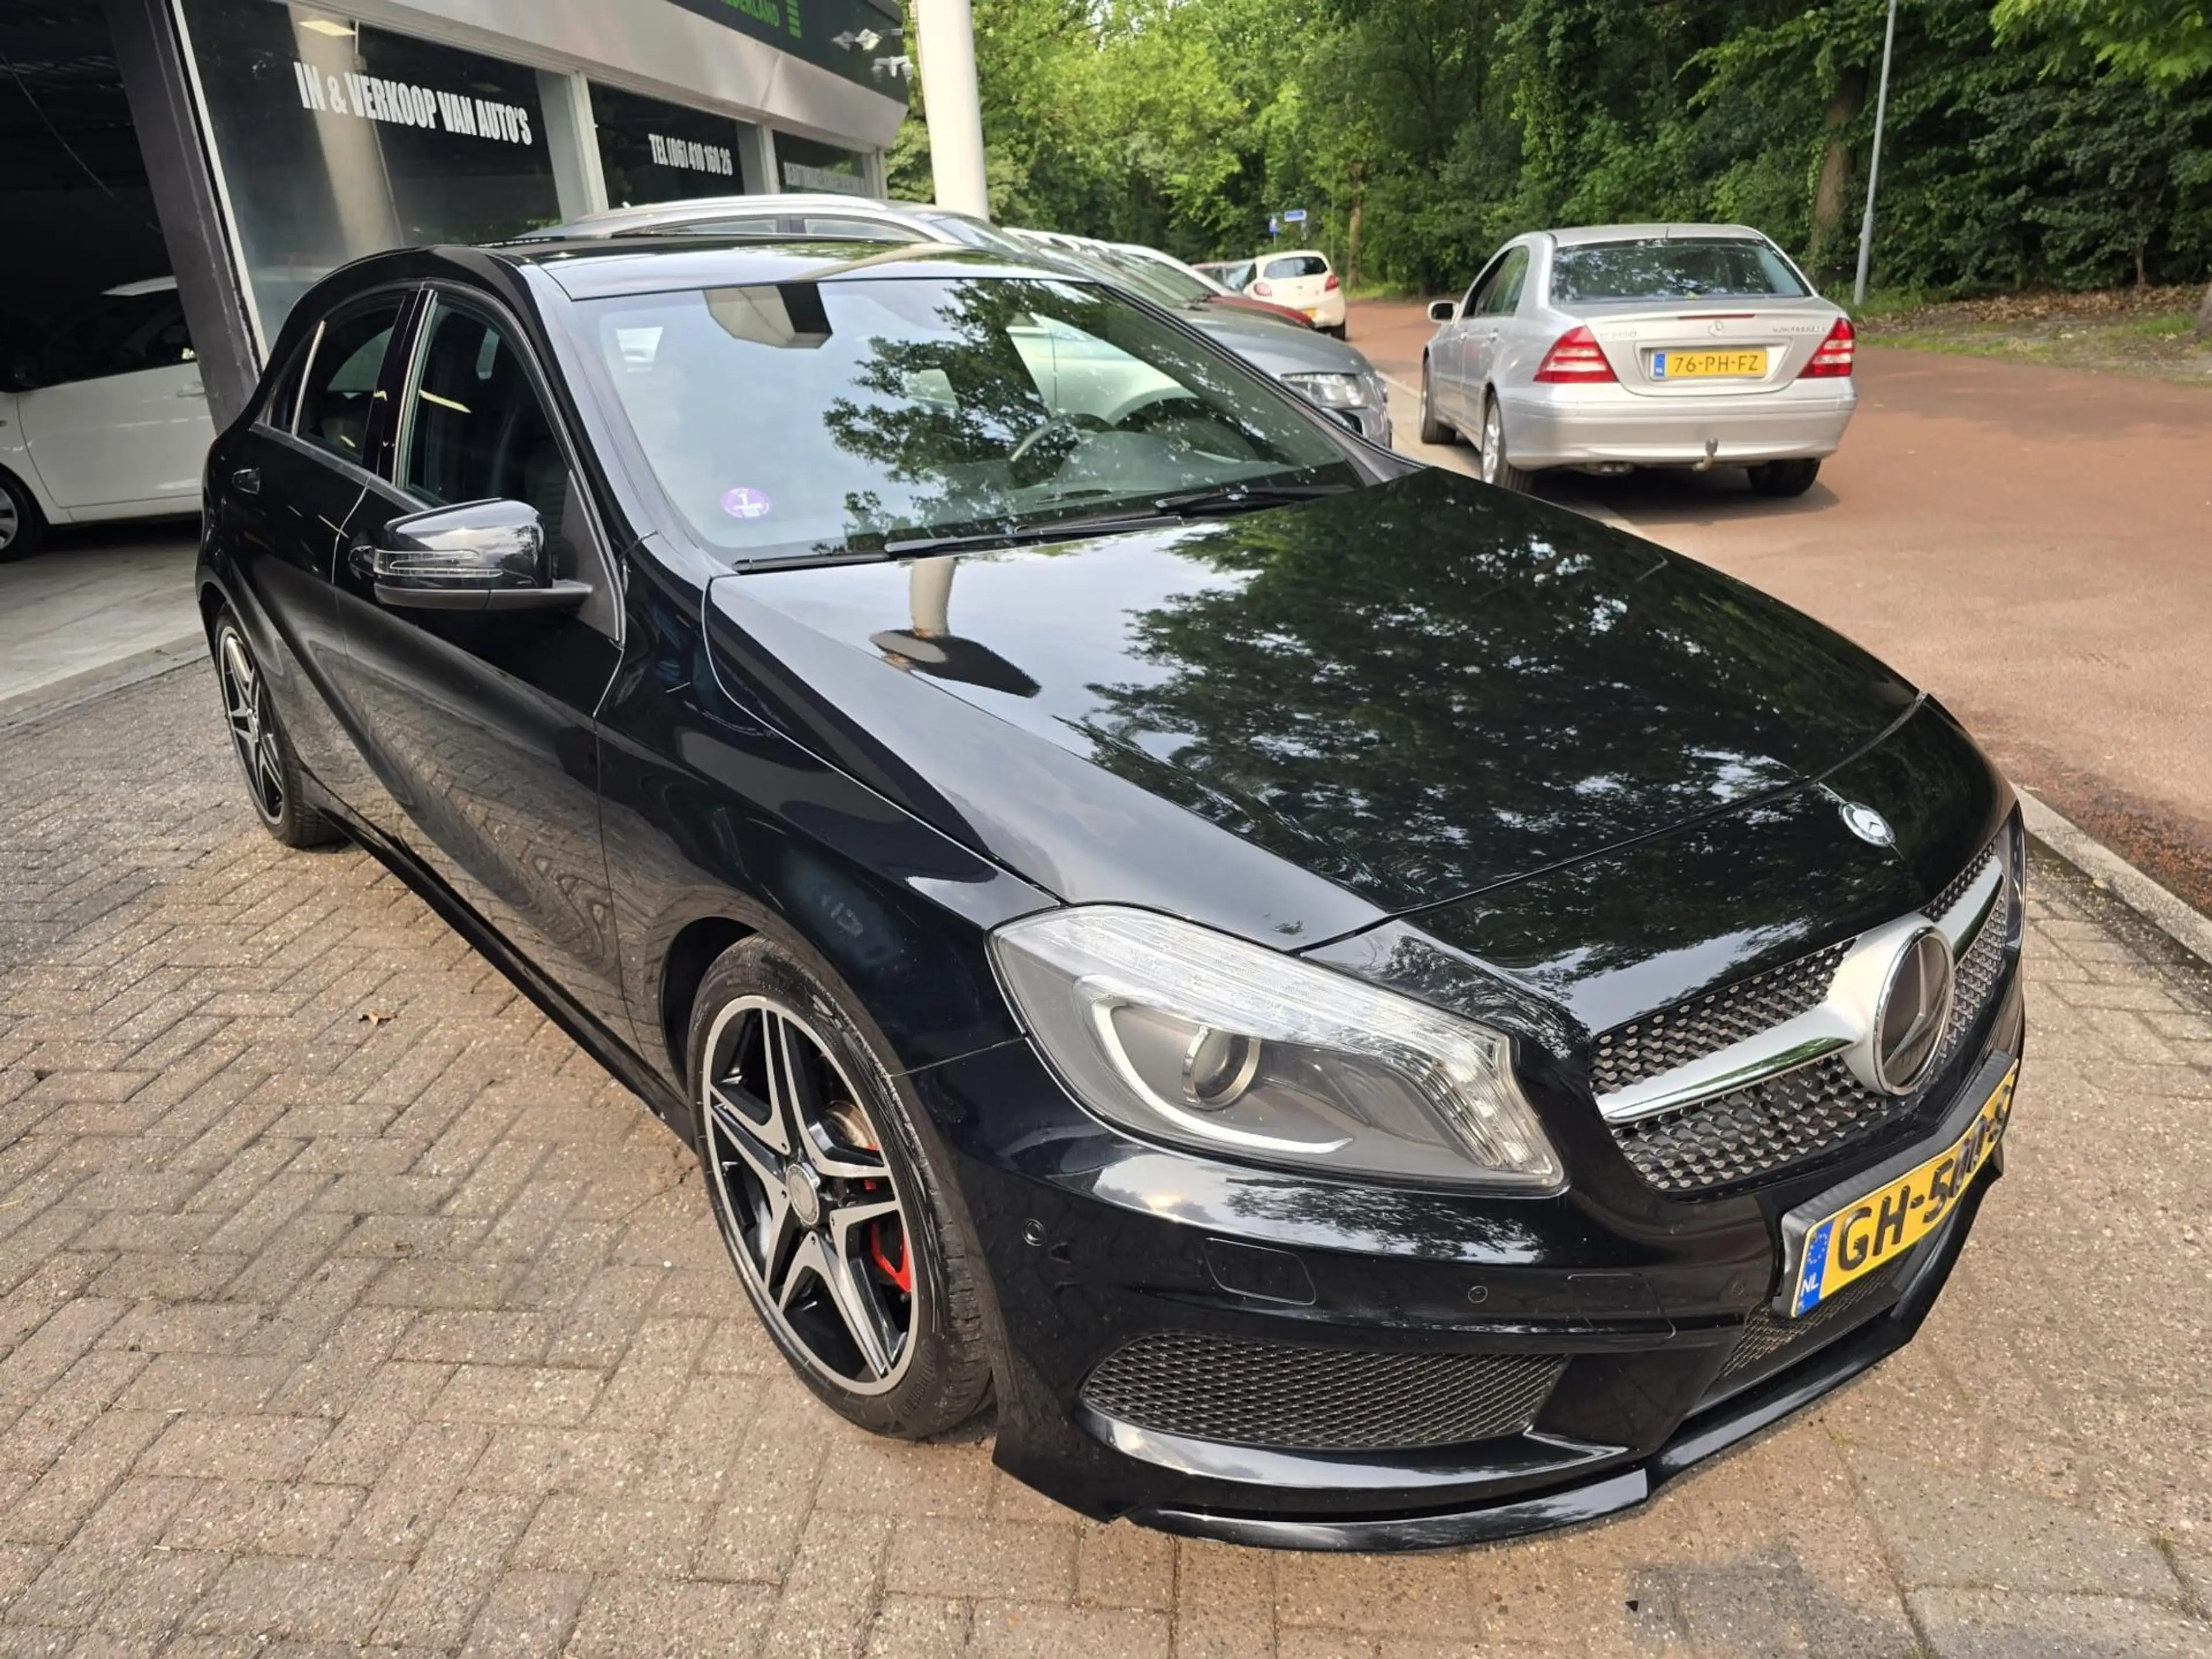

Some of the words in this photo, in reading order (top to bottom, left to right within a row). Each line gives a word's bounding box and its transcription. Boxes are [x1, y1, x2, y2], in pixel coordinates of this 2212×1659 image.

[293, 61, 327, 111] IN
[327, 75, 349, 114] &
[343, 72, 437, 129] VERKOOP
[436, 90, 478, 136] VAN
[475, 99, 532, 146] AUTO'S
[1675, 355, 1759, 373] 76-PH-FZ
[1801, 1271, 1820, 1297] NL
